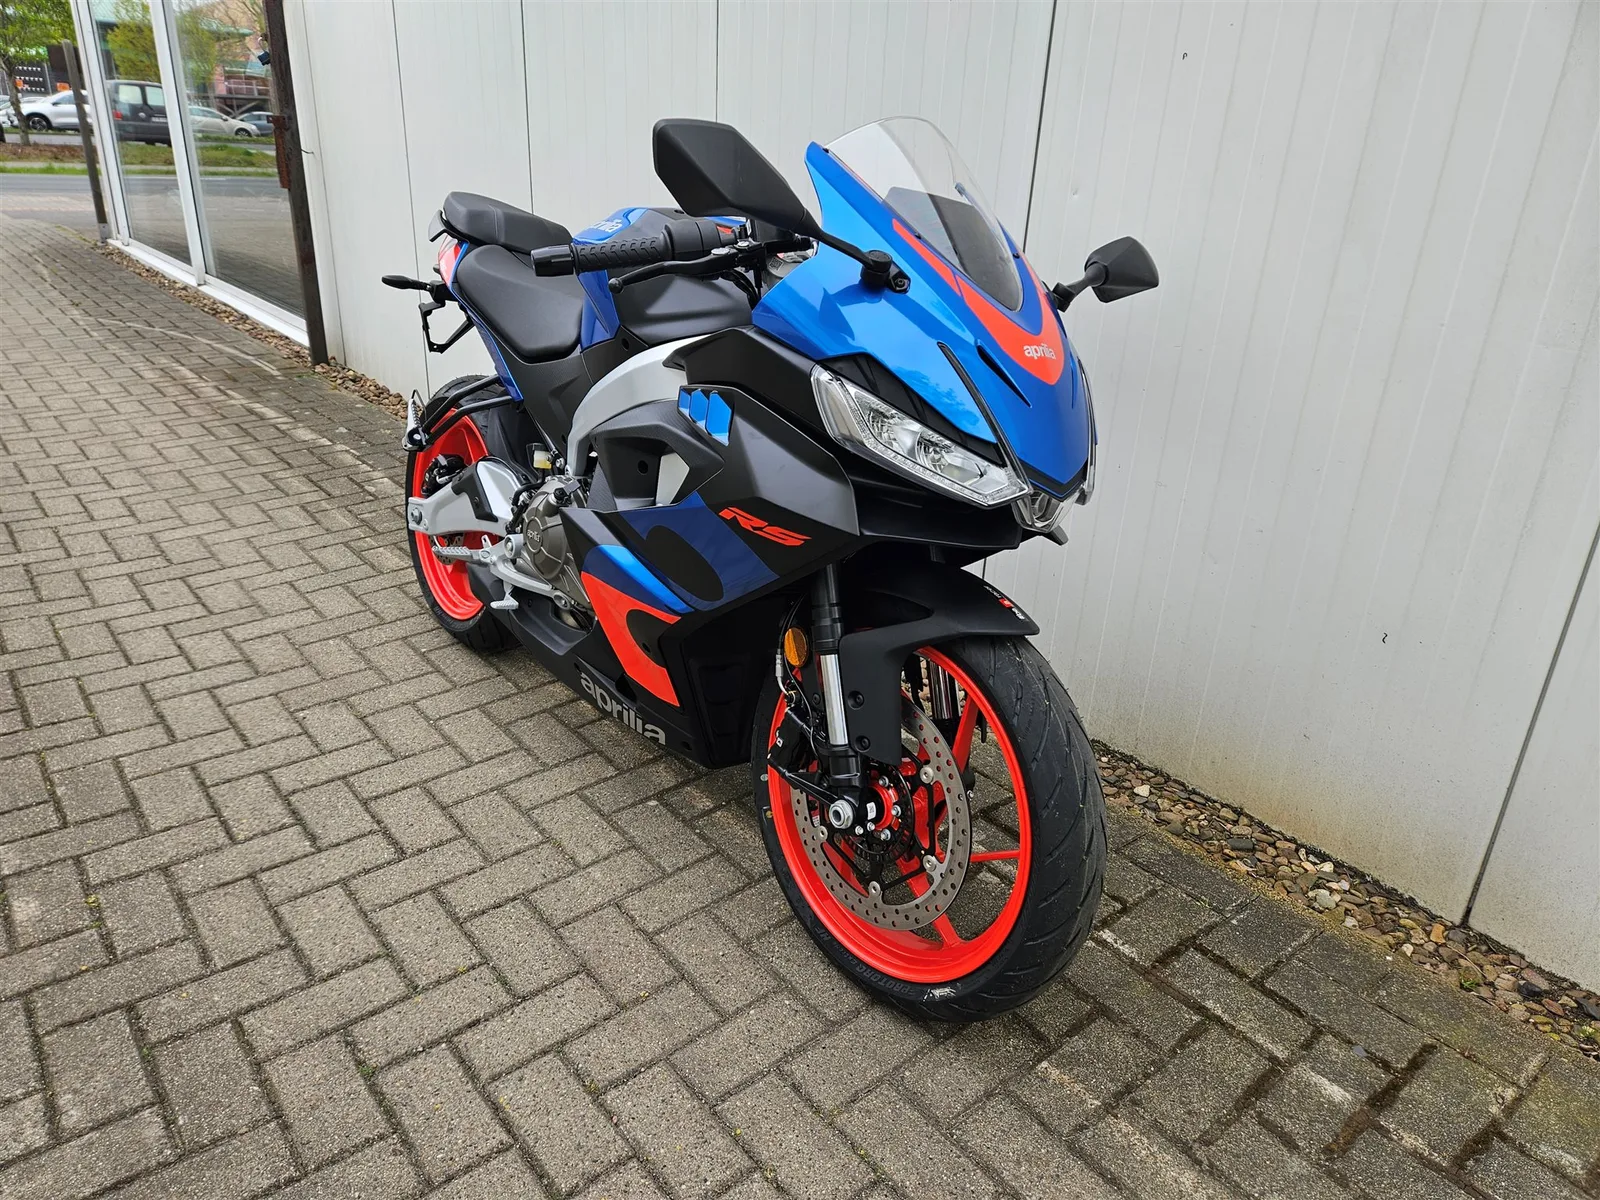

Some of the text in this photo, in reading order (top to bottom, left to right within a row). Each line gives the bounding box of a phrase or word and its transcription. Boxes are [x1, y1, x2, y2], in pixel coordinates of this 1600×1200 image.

[1023, 343, 1056, 360] aprilia
[718, 506, 812, 546] RS
[580, 671, 666, 746] aprilia
